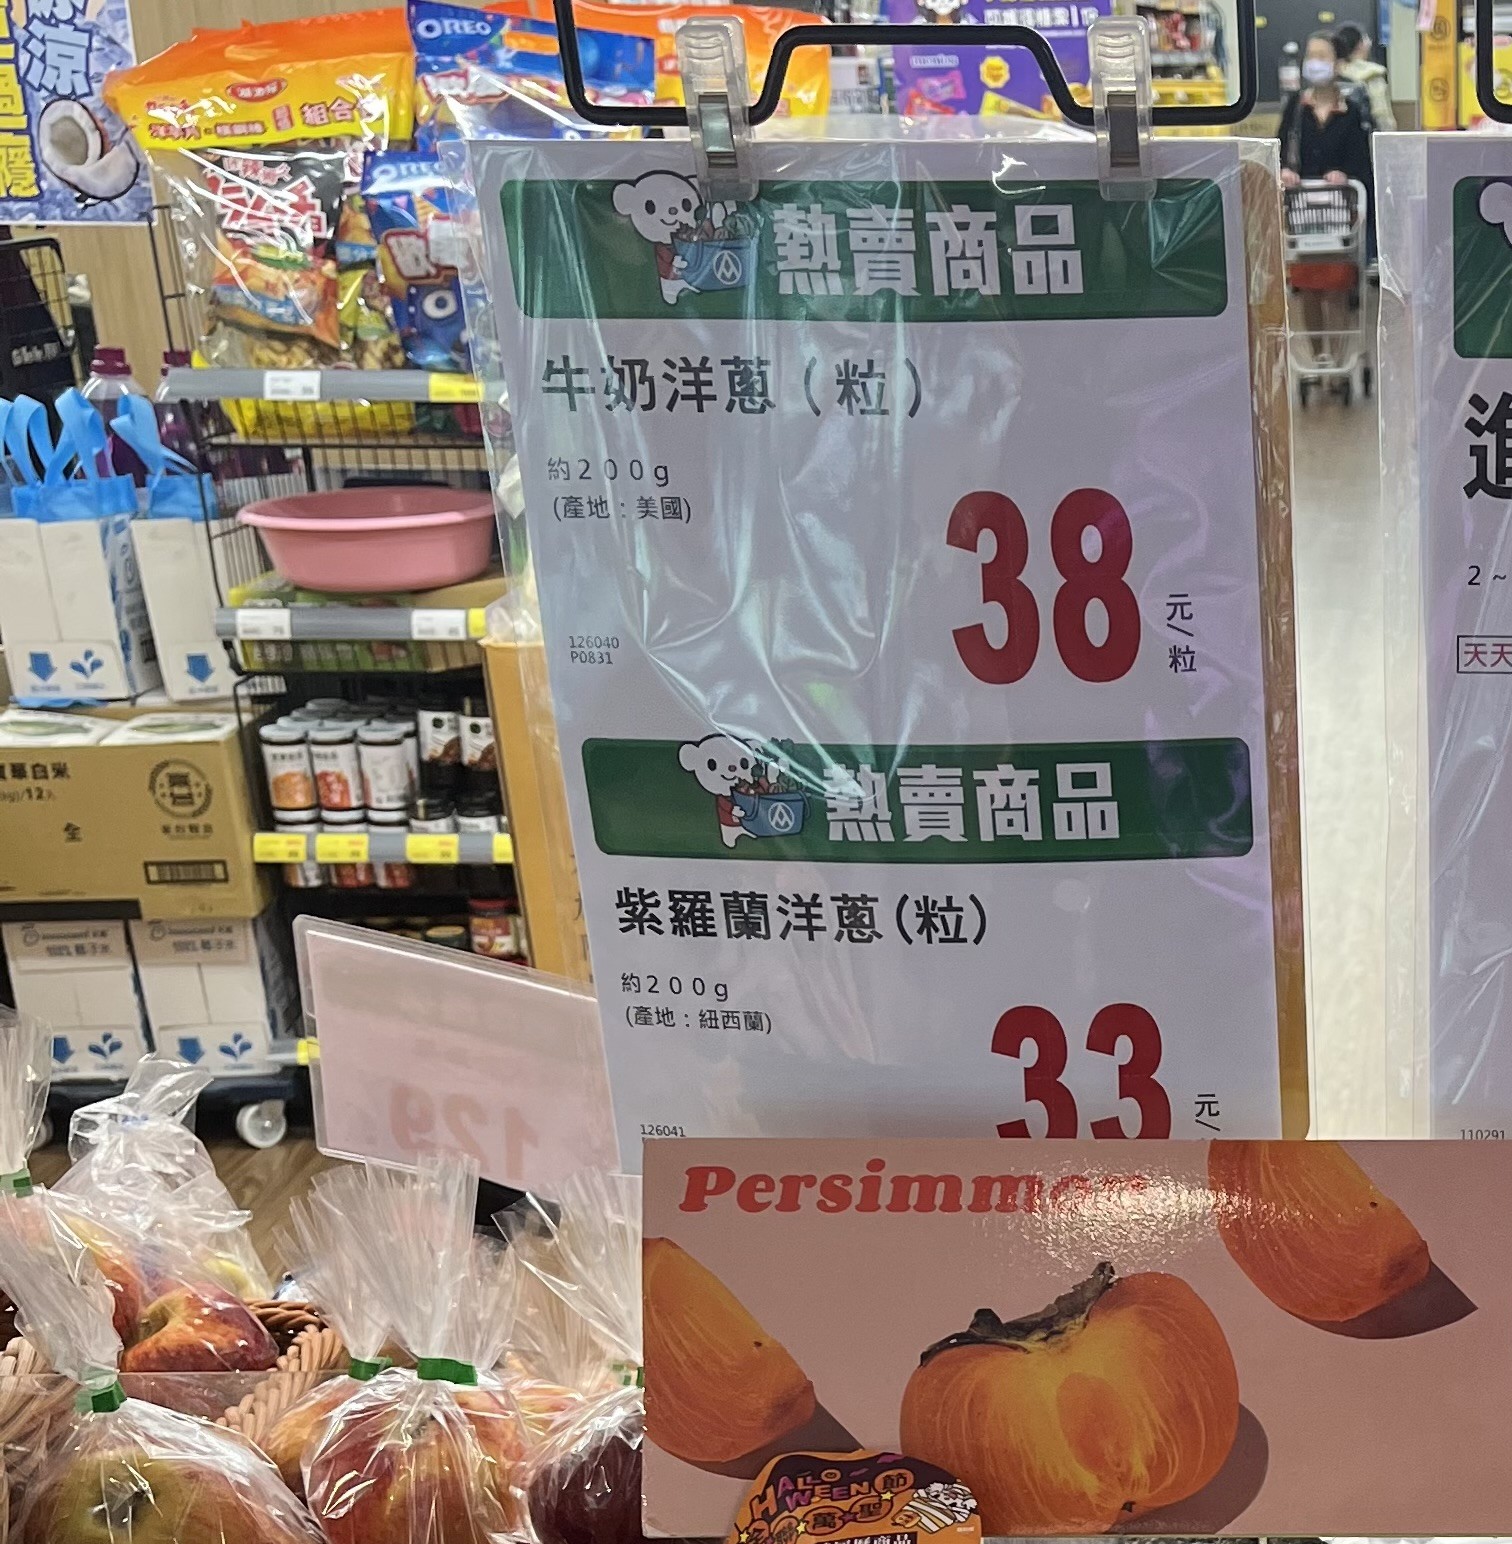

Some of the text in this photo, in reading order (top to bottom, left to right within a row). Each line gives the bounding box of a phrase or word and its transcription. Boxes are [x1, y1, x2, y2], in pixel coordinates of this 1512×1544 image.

[415, 18, 492, 38] OREO
[770, 201, 1085, 298] 熱賣商品
[547, 455, 671, 488] 約200g
[552, 494, 692, 523] (產地：美國)
[944, 486, 1142, 685] 38
[567, 635, 621, 650] 126040
[569, 650, 614, 666] P0831
[823, 760, 1121, 845] 熱賣商品
[613, 887, 989, 946] 紫羅蘭洋蔥(粒)
[620, 971, 730, 1002] 約200g
[624, 1004, 774, 1036] (產地：紐西蘭)
[990, 1002, 1173, 1140] 33
